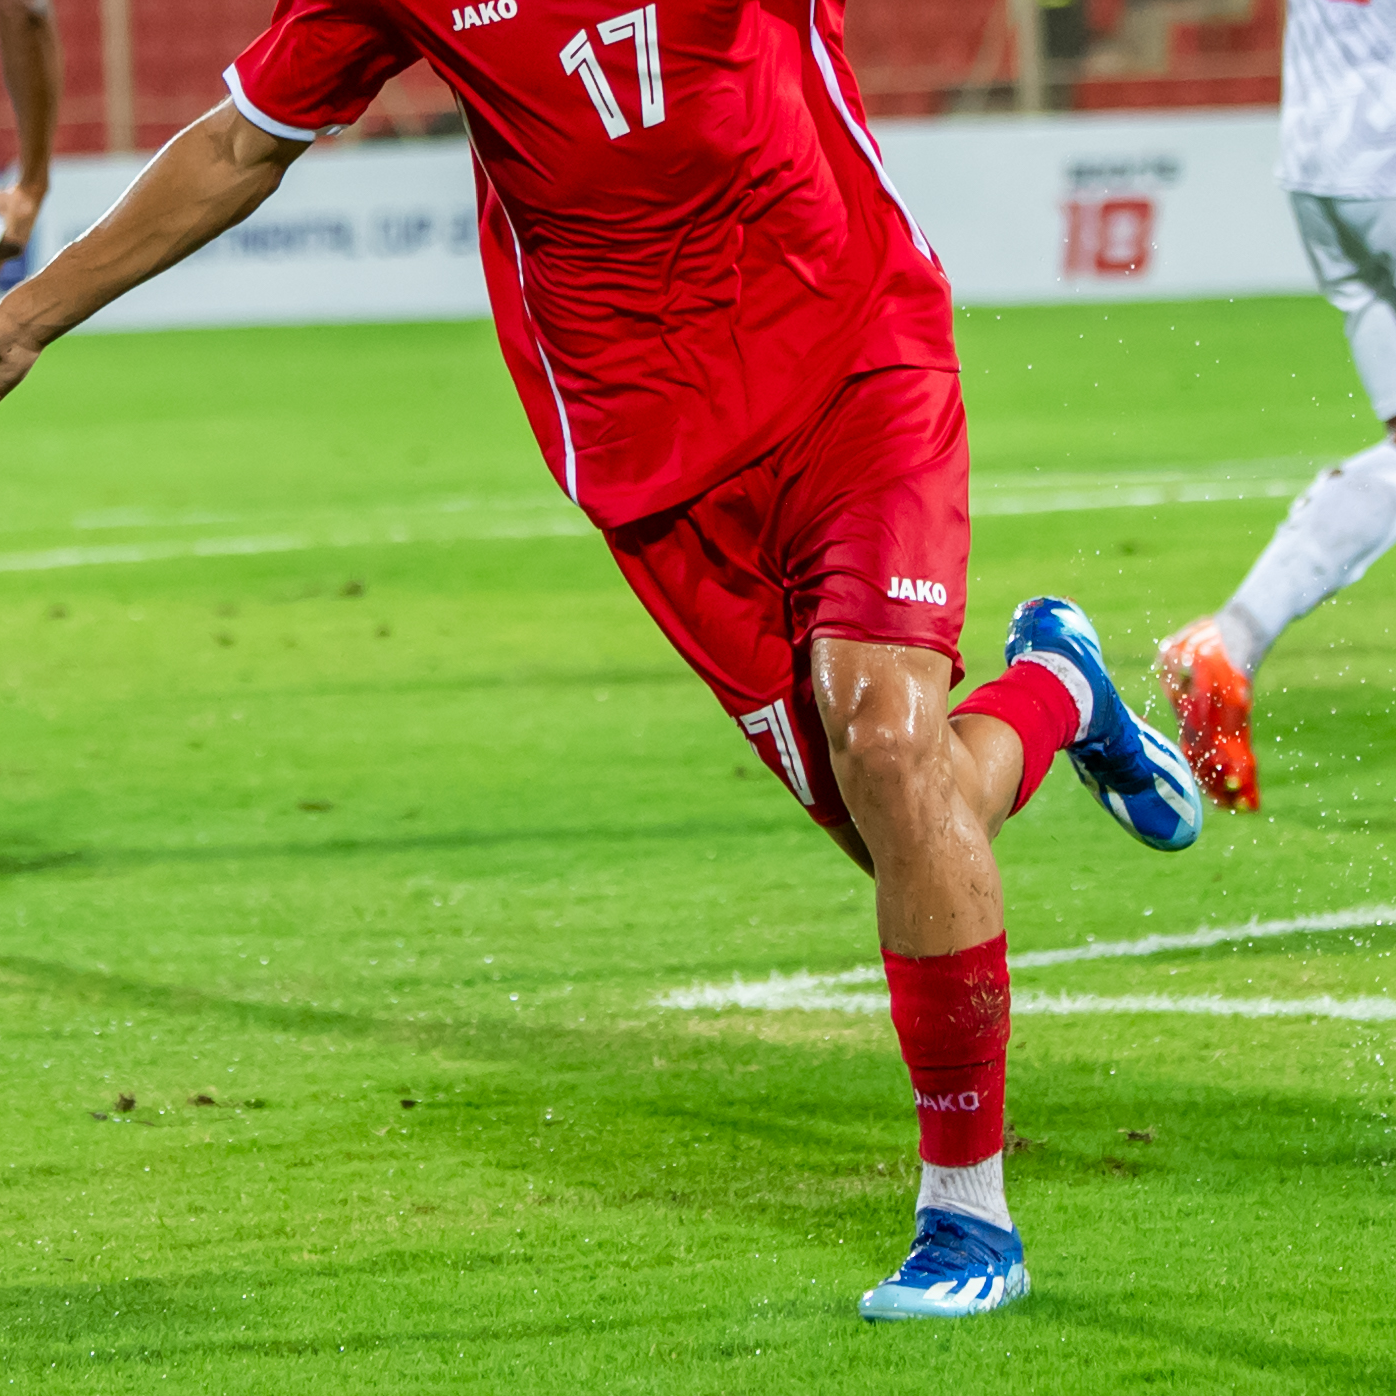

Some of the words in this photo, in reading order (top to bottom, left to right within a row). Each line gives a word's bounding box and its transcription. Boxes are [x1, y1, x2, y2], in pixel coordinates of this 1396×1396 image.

[559, 3, 666, 140] 17
[887, 577, 947, 606] JAKO
[732, 697, 816, 806] 7
